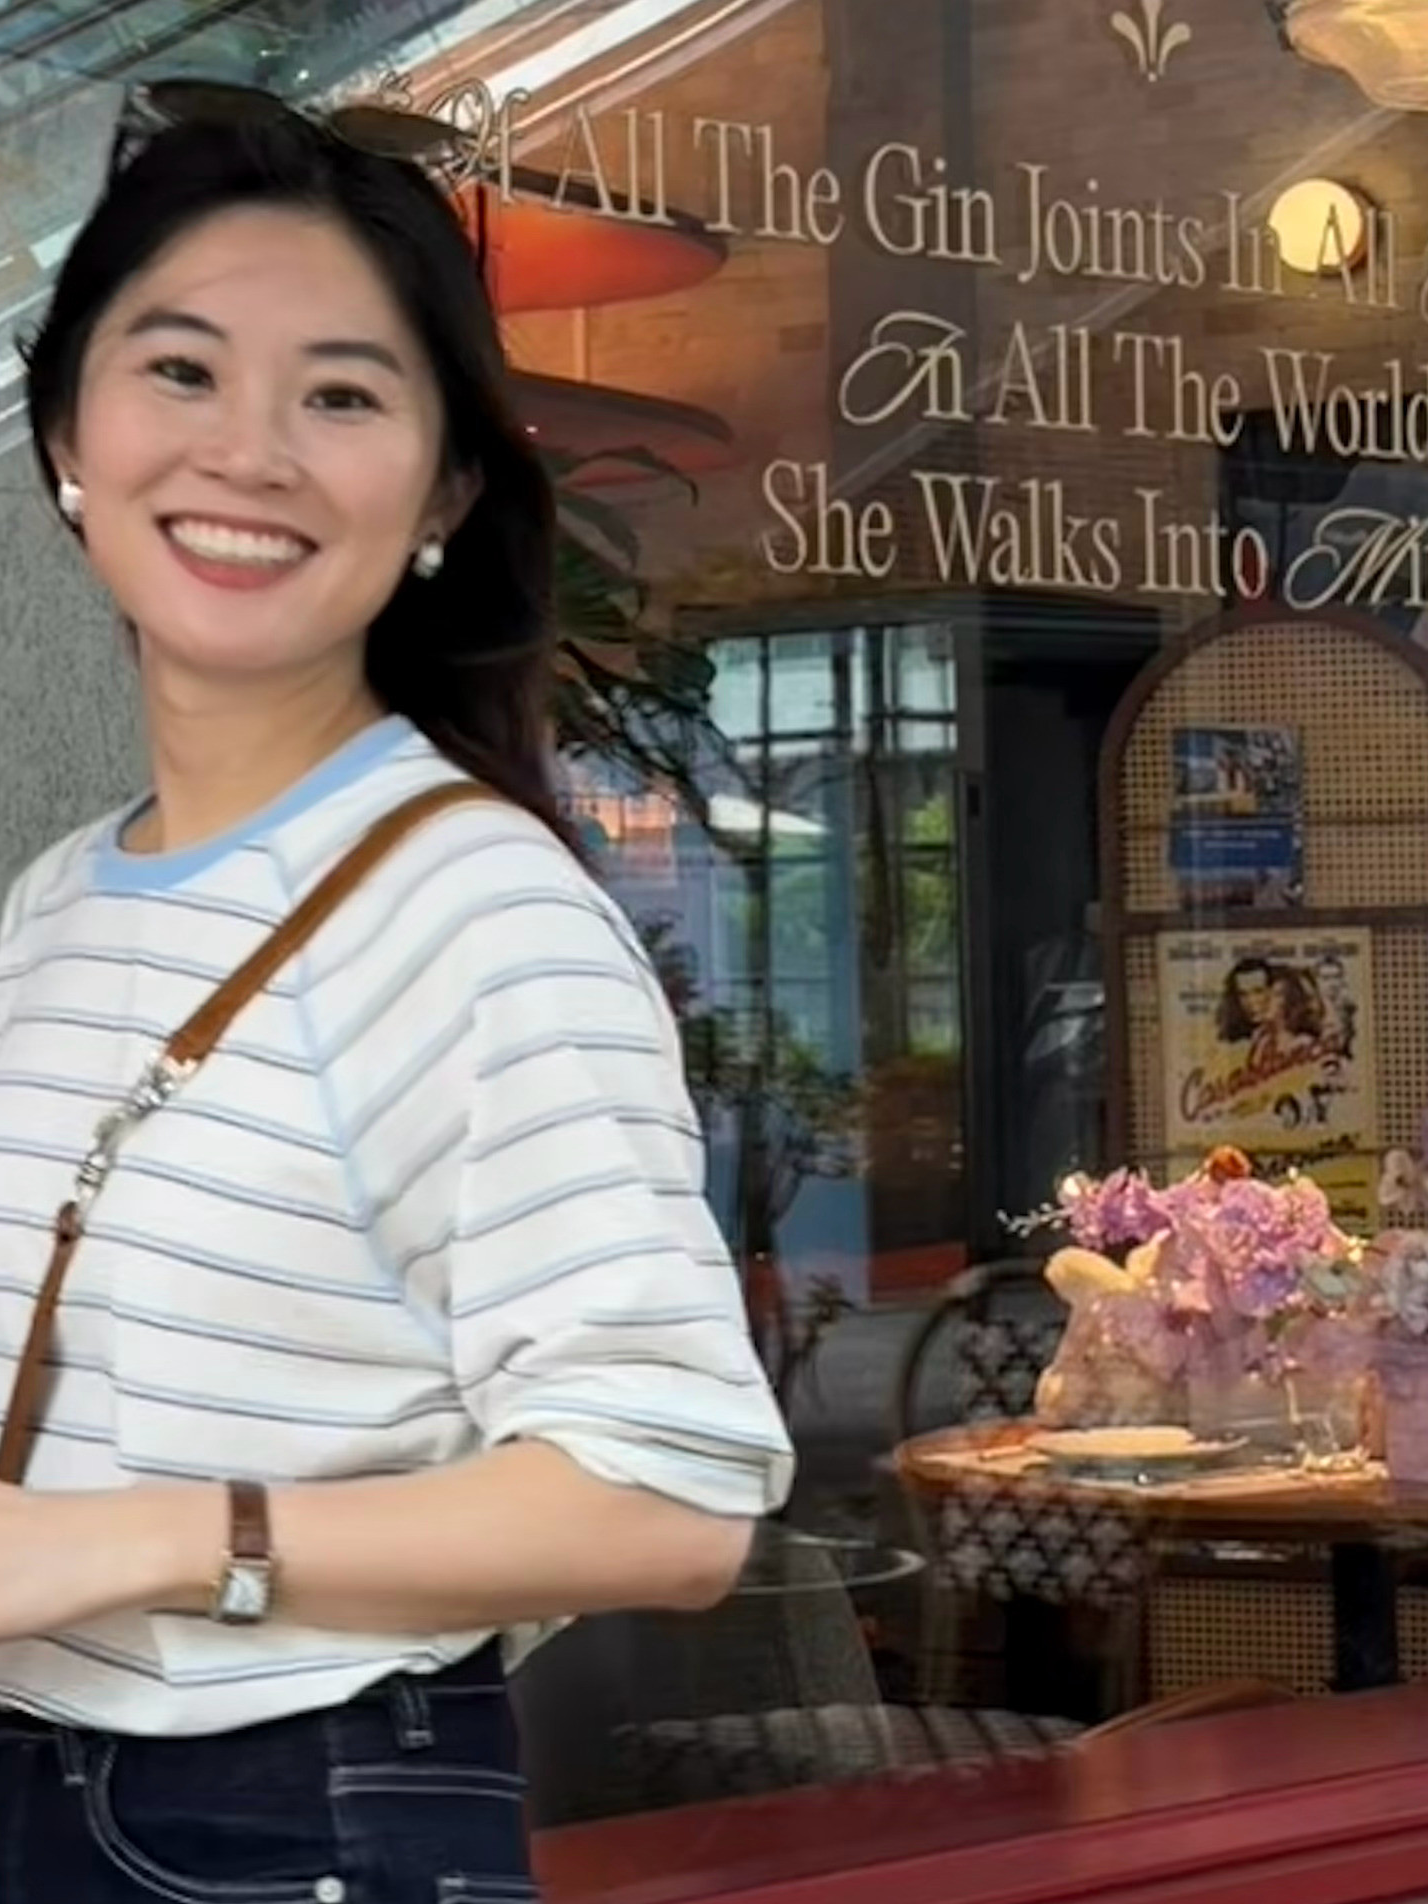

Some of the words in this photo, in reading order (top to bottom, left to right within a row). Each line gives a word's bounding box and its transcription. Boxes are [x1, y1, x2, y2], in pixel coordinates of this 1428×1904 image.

[545, 102, 677, 226] All
[693, 116, 845, 245] The
[863, 141, 1003, 267] Gin
[1017, 161, 1206, 290] Joints
[1219, 190, 1285, 296] In
[1302, 202, 1401, 310] All
[838, 310, 972, 427] In
[991, 320, 1095, 435] All
[1112, 332, 1244, 448] The
[760, 459, 898, 578] She
[912, 470, 1122, 593] Walks
[1134, 487, 1271, 600] Into
